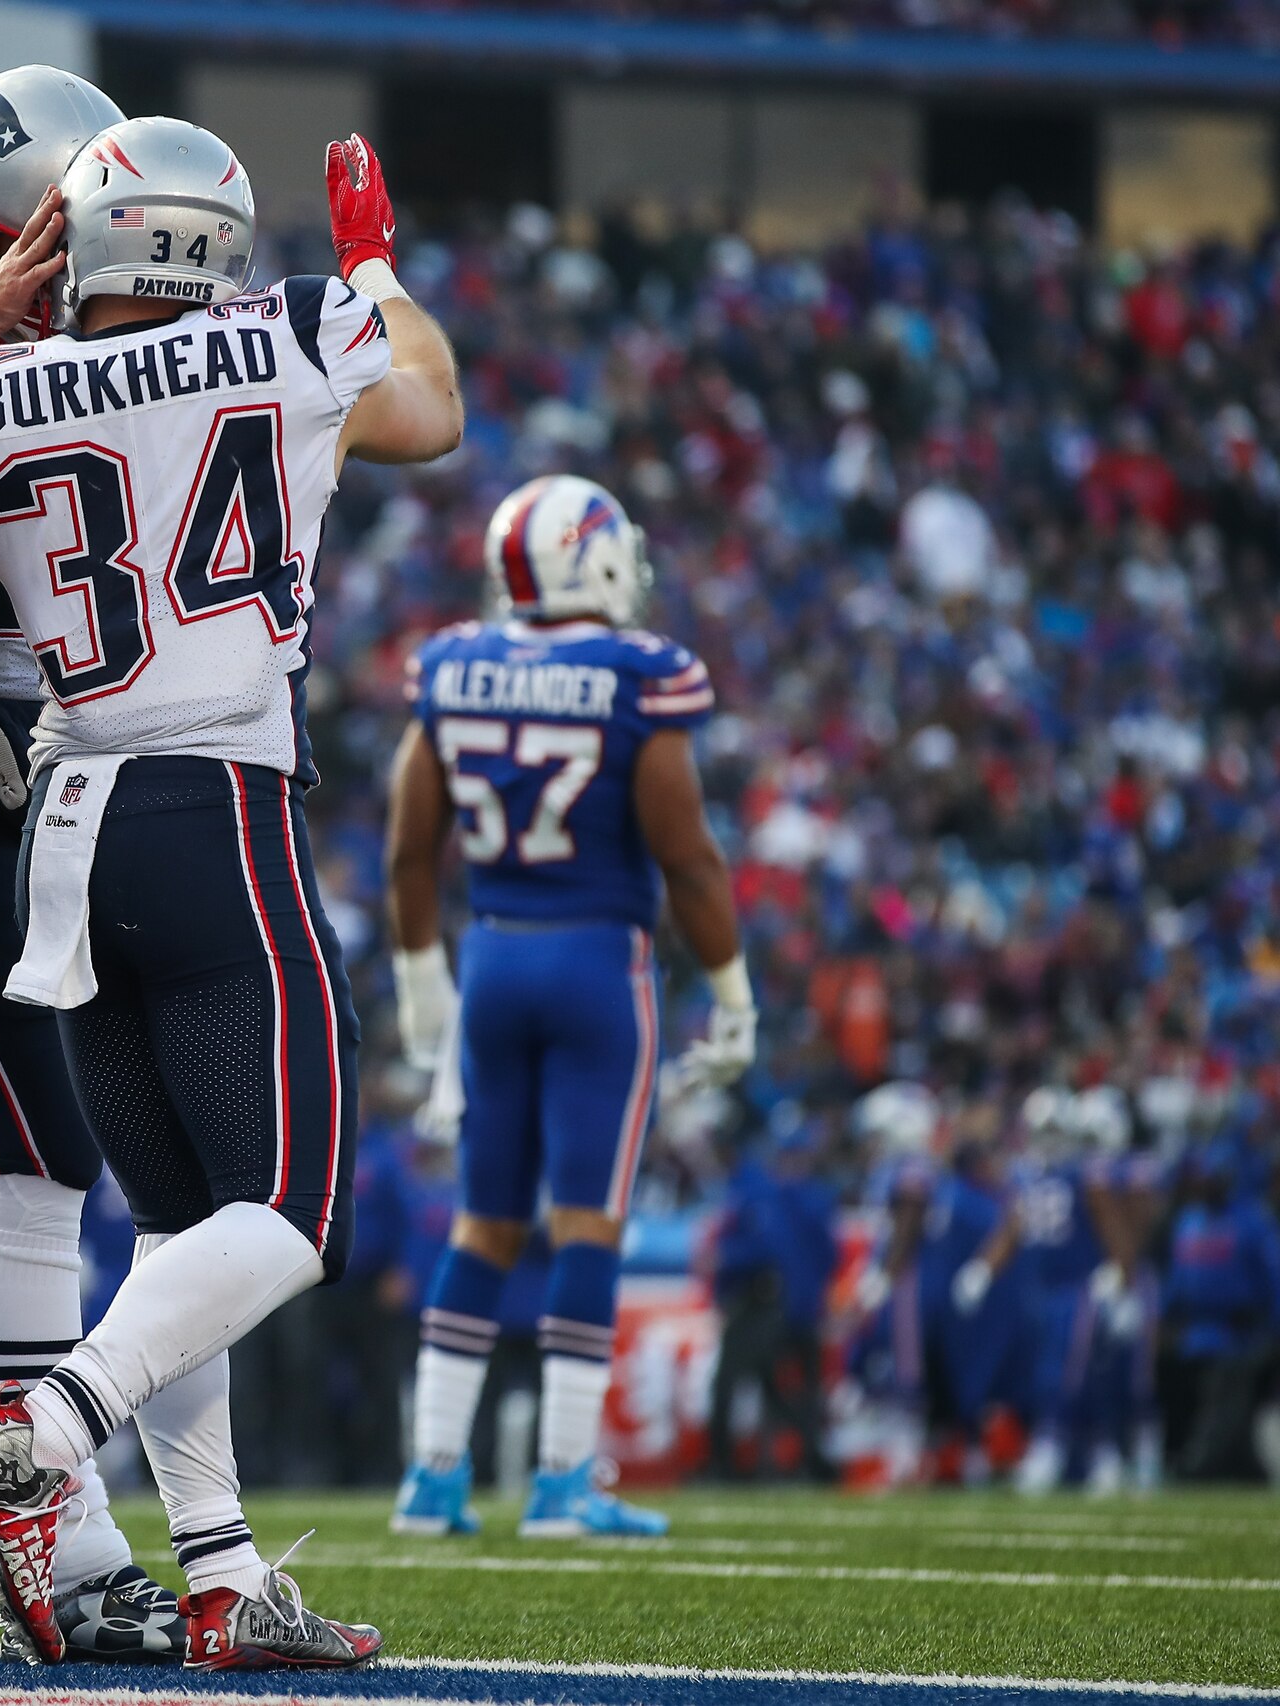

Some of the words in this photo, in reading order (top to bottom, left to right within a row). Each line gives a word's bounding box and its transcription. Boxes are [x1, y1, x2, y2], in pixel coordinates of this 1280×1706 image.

[133, 277, 214, 301] PATRIOTS
[434, 660, 618, 719] ALEXANDER
[61, 787, 82, 803] NFL
[437, 717, 602, 864] 57
[45, 815, 78, 828] Wilson
[21, 1522, 50, 1608] TEAM
